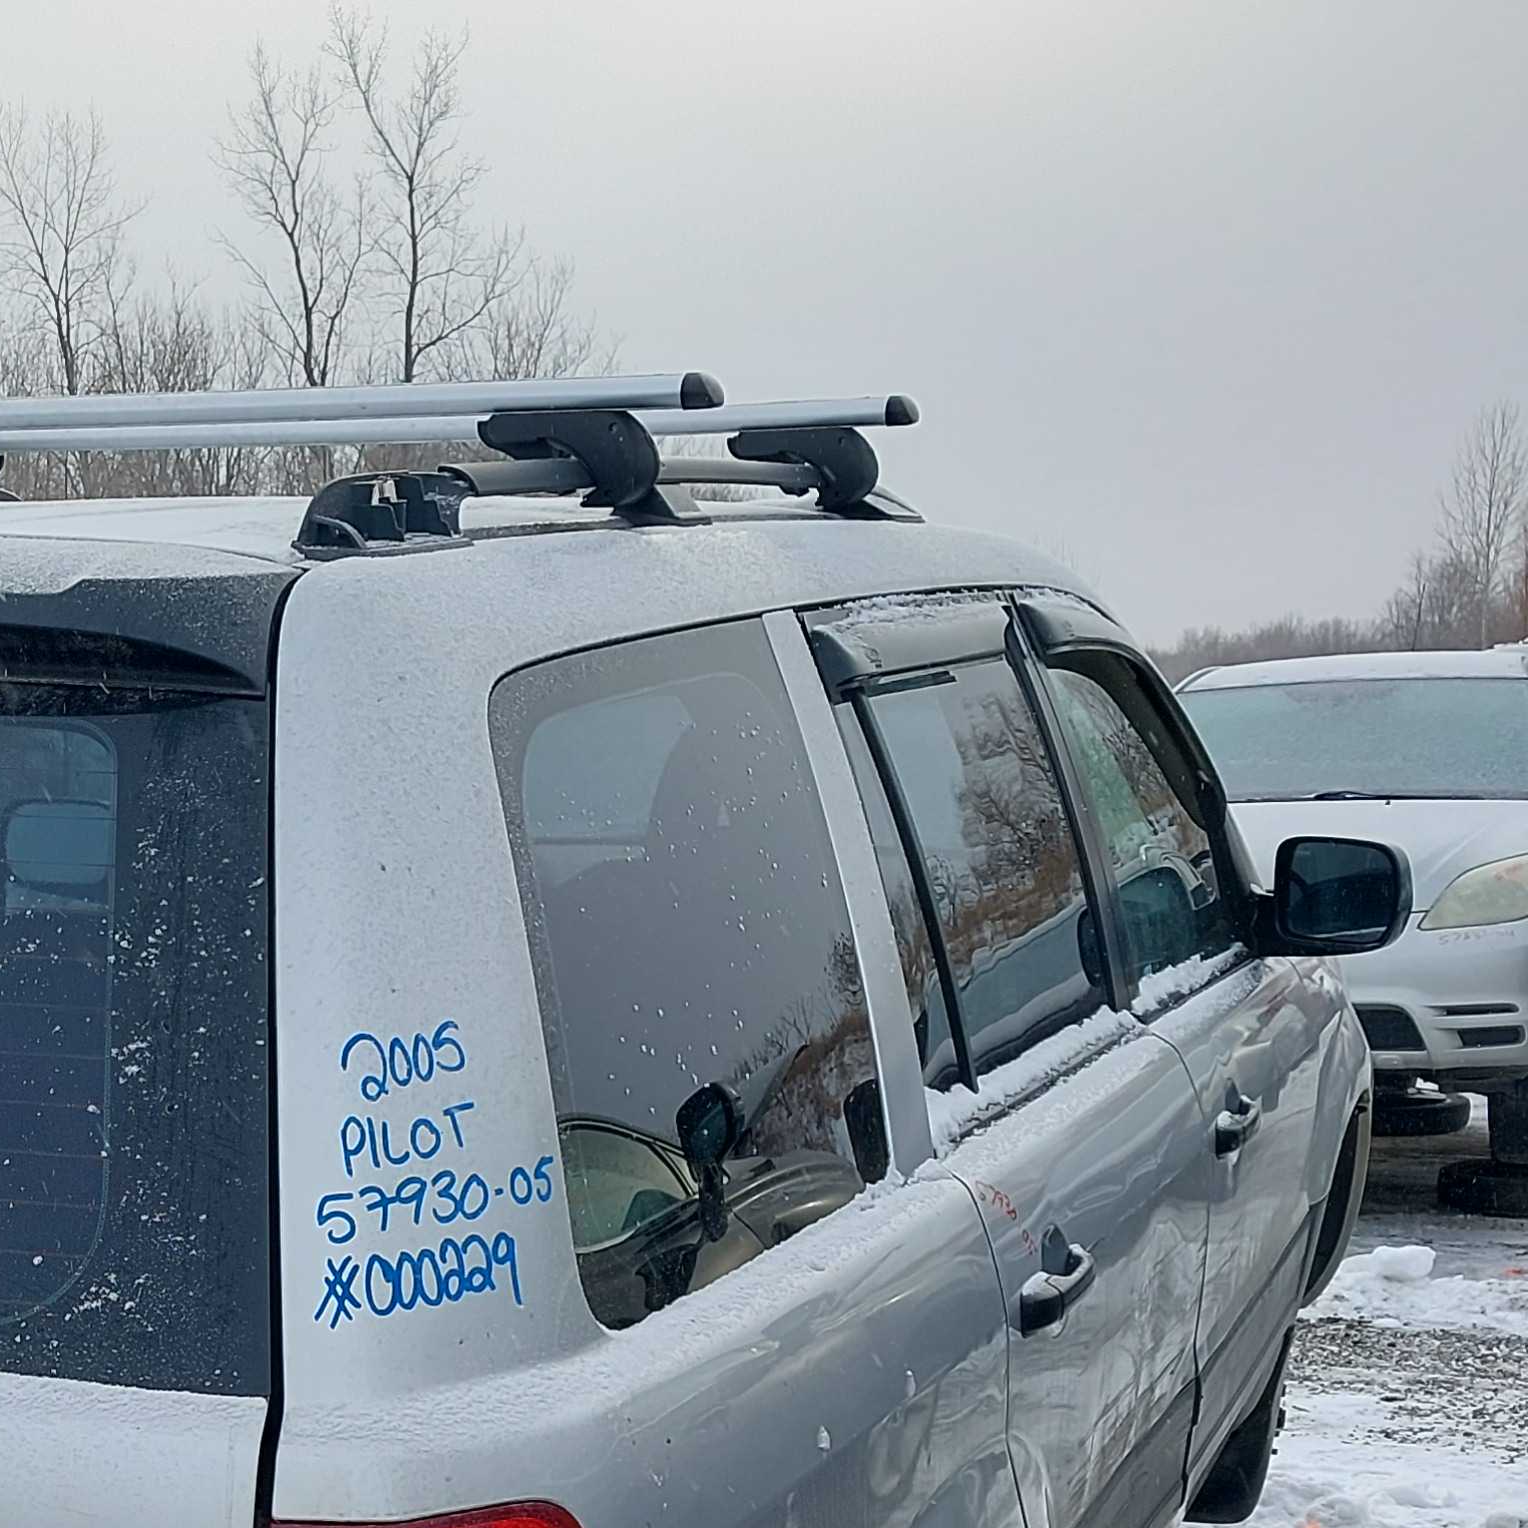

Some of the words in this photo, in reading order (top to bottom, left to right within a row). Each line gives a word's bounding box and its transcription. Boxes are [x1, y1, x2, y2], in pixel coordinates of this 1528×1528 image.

[340, 1020, 466, 1101] 2005
[340, 1101, 475, 1178] PILOT
[317, 1155, 554, 1244] 57930-05
